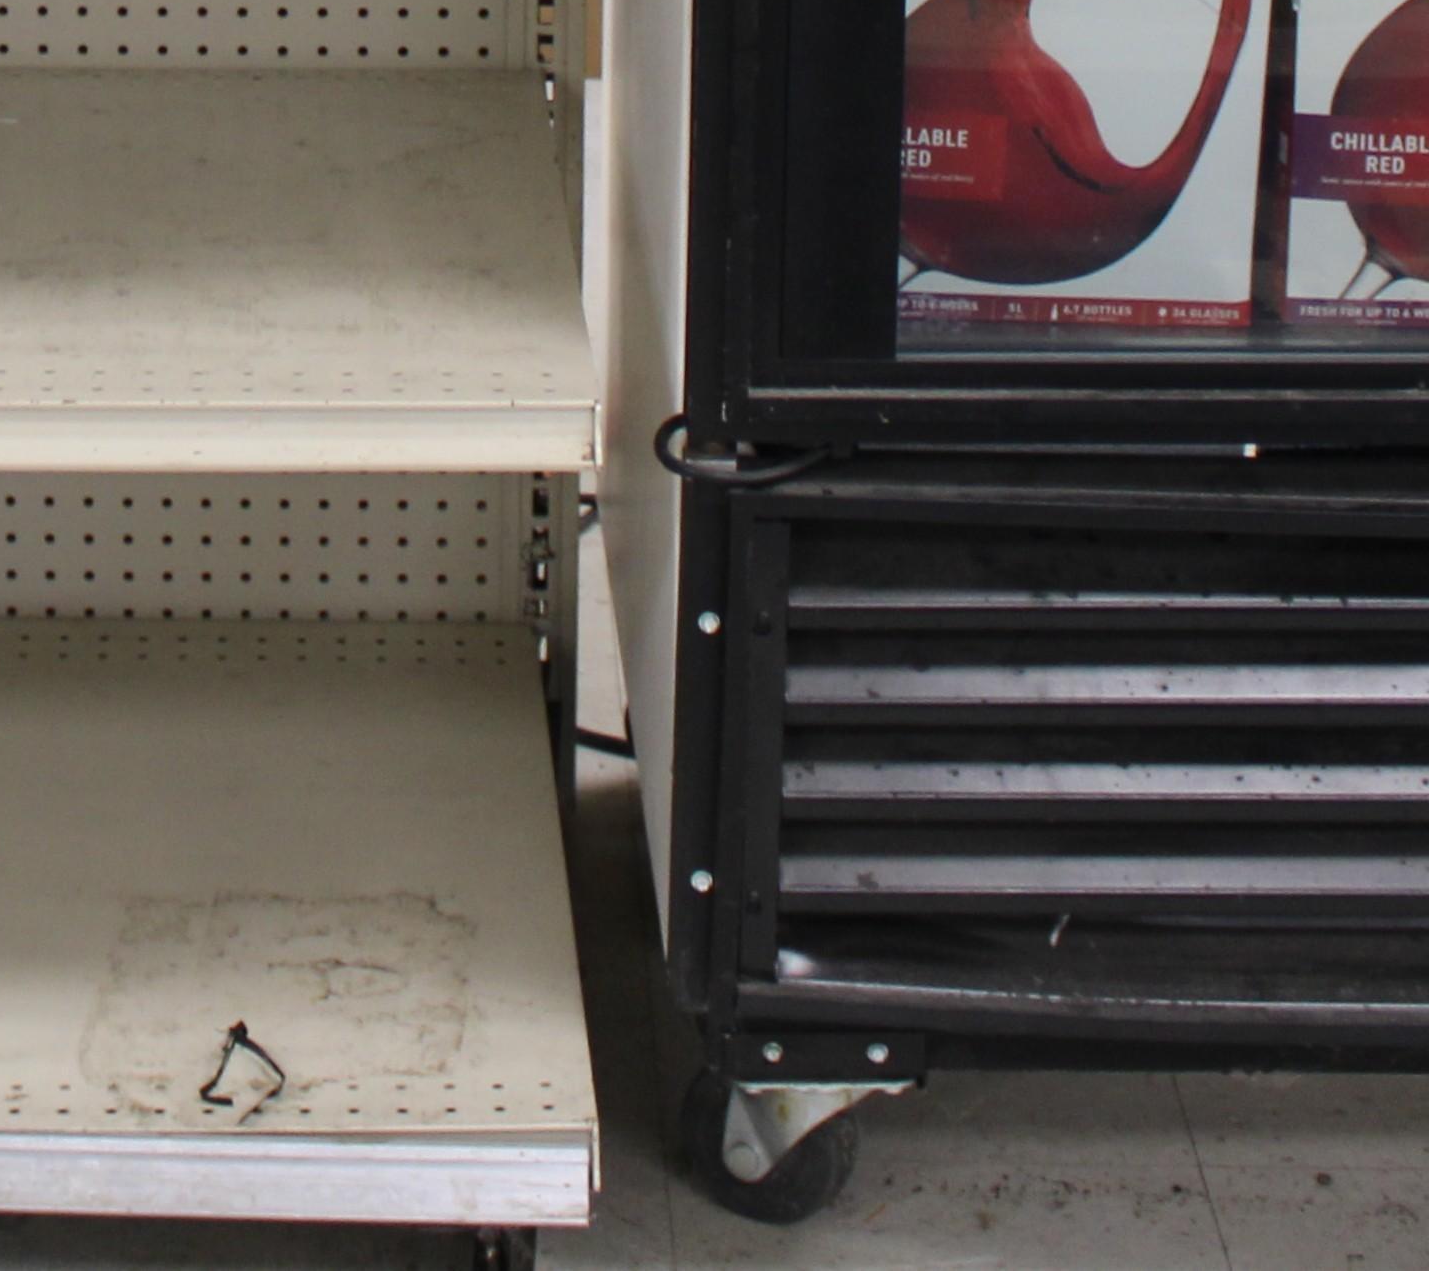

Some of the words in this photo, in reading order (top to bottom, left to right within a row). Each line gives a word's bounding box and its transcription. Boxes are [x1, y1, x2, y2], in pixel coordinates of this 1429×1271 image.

[905, 127, 969, 148] LABLE
[1365, 155, 1406, 174] RED
[1082, 306, 1132, 317] BOTTLES
[1300, 307, 1338, 317] FRESH
[1341, 307, 1363, 318] FOR
[1366, 308, 1382, 318] UP
[1385, 308, 1399, 318] TO
